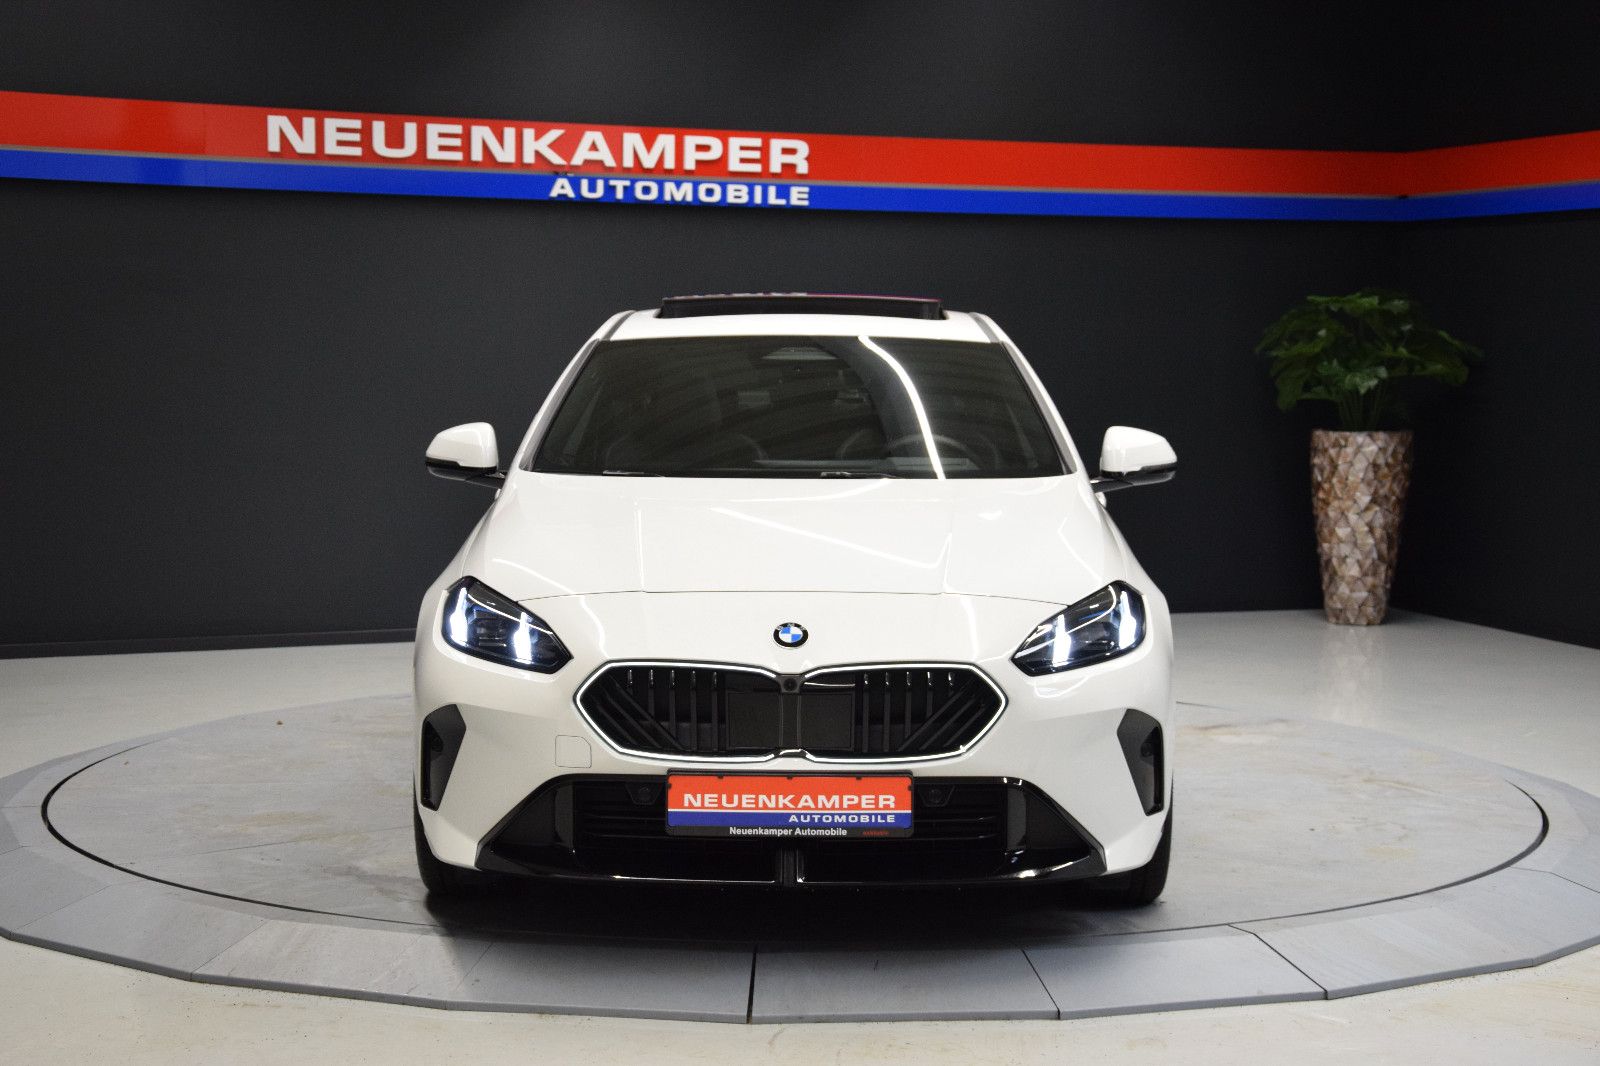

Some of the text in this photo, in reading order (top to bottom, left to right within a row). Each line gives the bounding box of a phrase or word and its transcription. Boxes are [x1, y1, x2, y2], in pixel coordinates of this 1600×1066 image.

[266, 114, 810, 175] NEUENKAMPER
[549, 177, 810, 206] AUTOMOBILE
[683, 793, 896, 809] NEUENKAMPER
[789, 814, 896, 824] AUTOMOBILE
[729, 826, 848, 837] Neuenkamper Automobile
